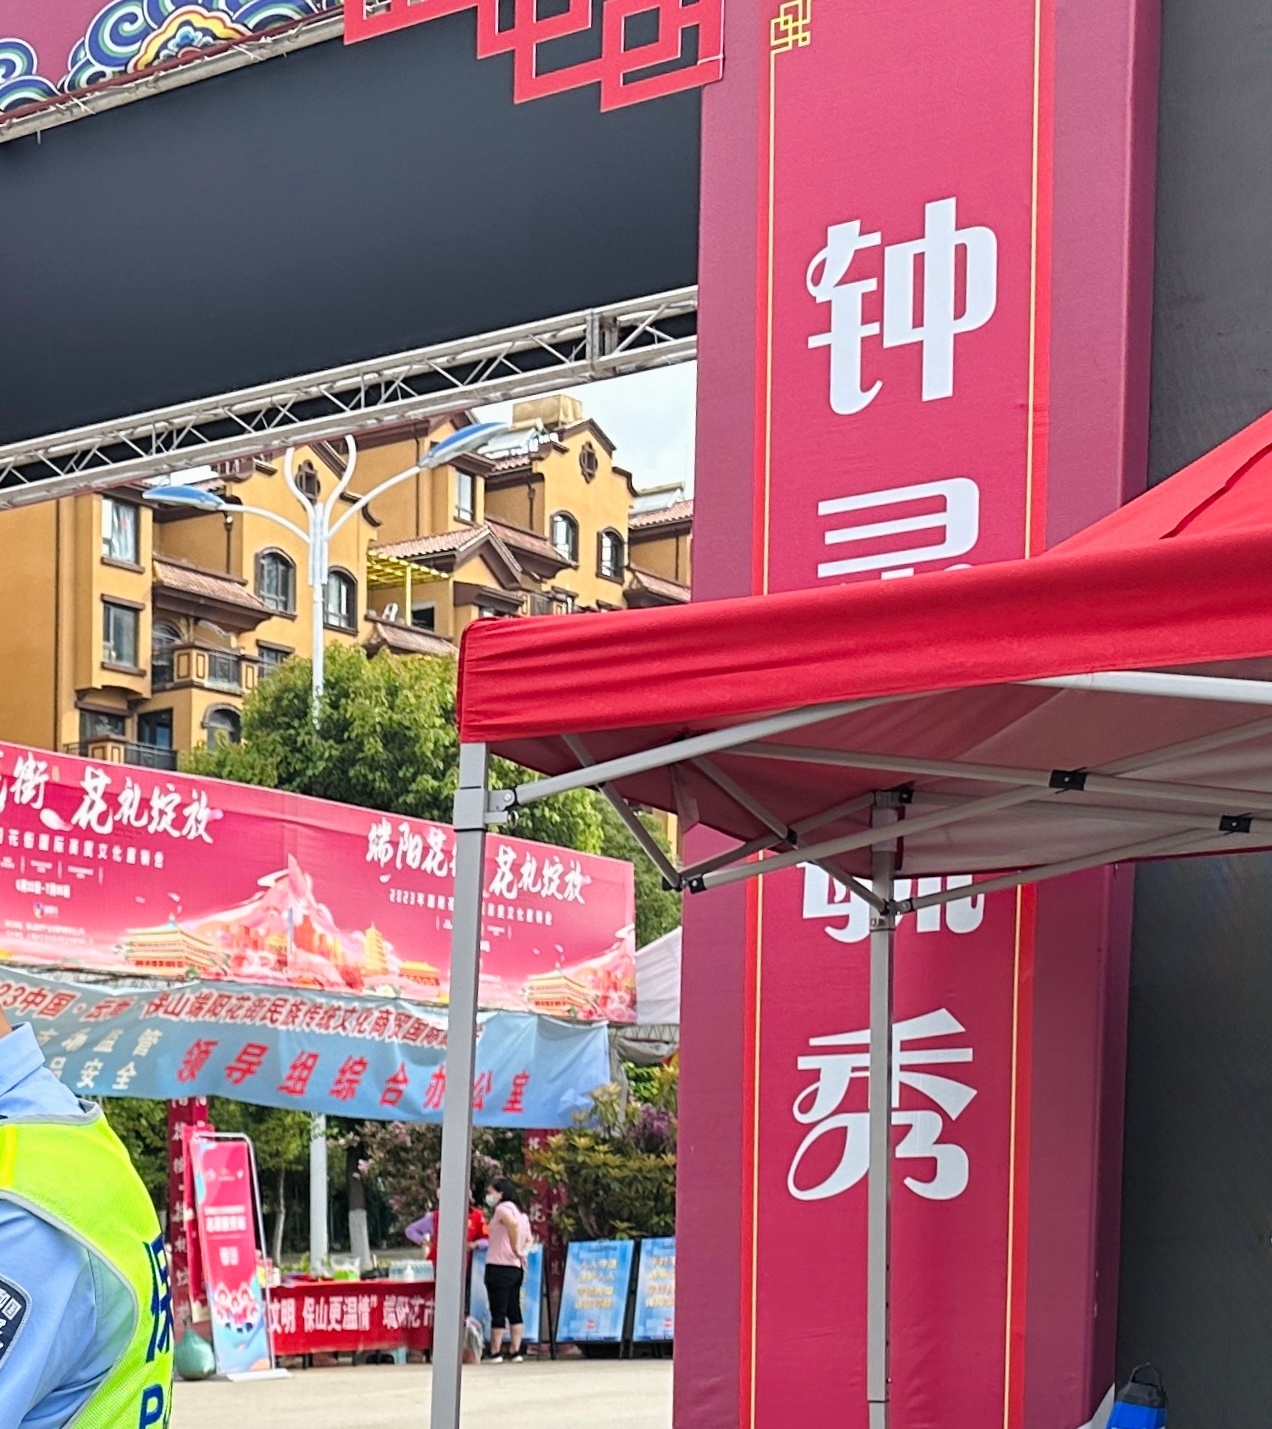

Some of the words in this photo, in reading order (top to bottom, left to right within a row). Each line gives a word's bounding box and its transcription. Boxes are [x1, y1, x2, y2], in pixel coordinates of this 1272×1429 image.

[71, 764, 214, 844] 花礼绽放
[366, 817, 456, 878] 端阳花
